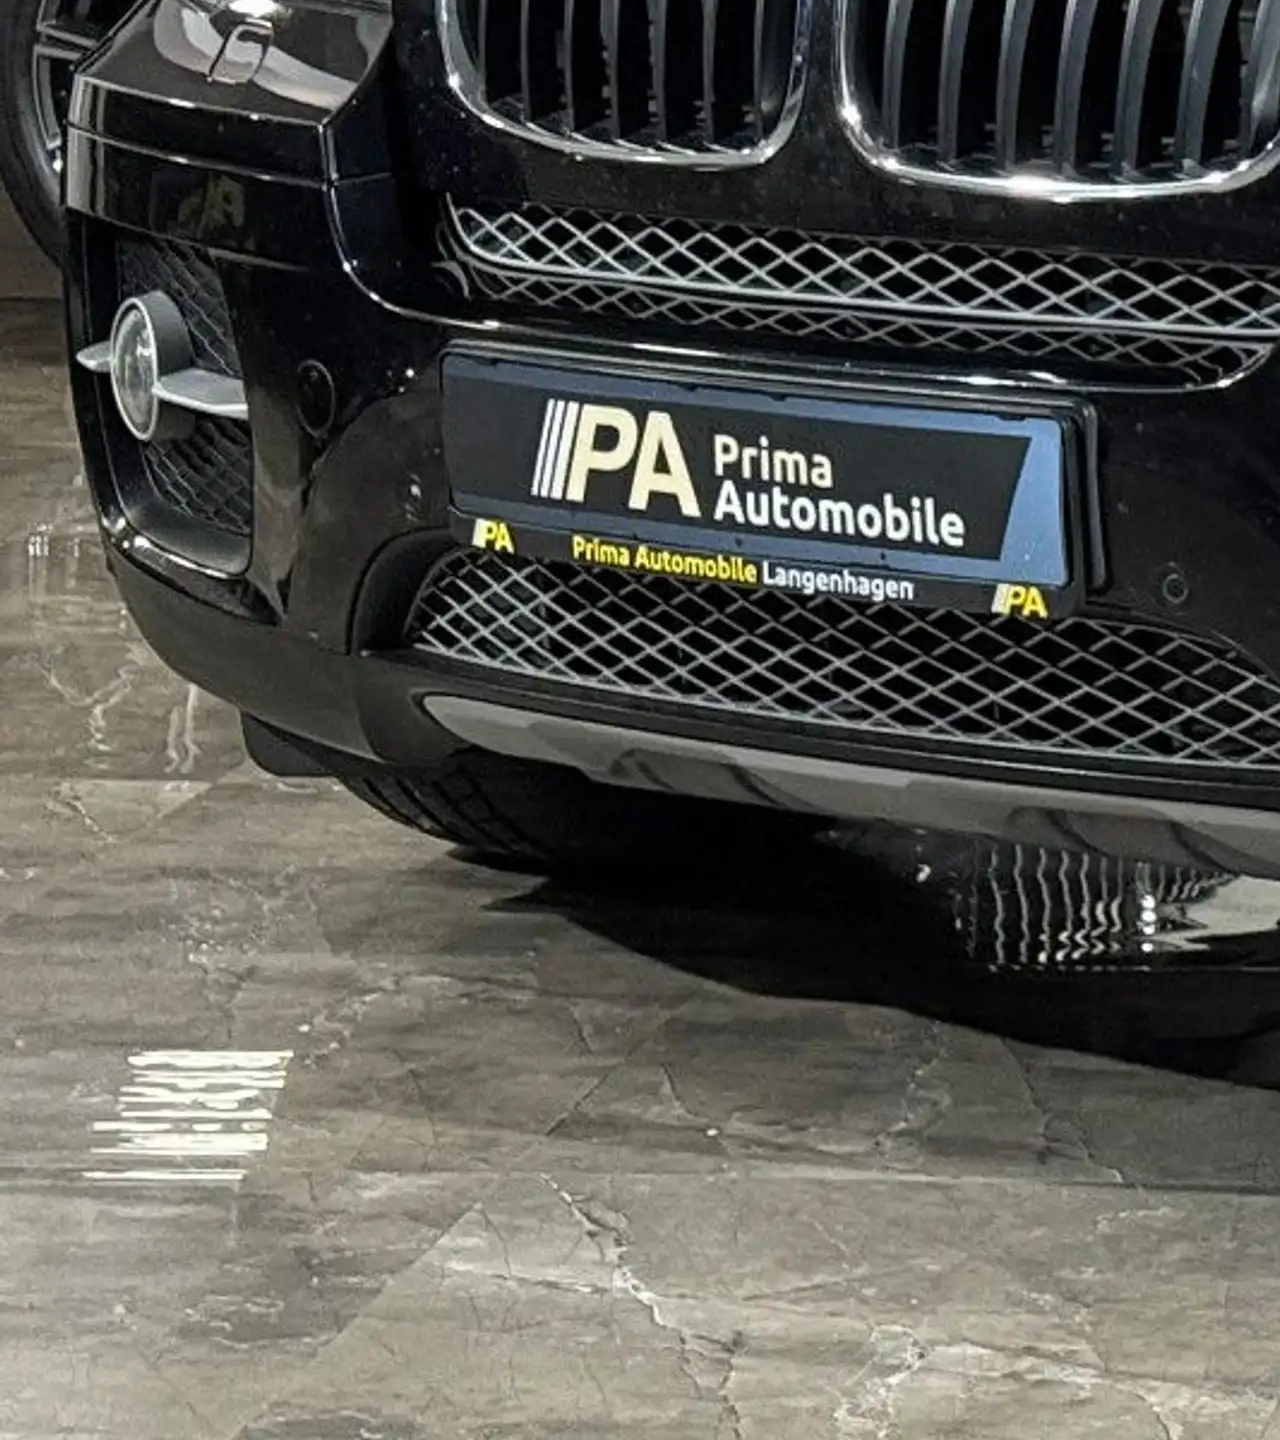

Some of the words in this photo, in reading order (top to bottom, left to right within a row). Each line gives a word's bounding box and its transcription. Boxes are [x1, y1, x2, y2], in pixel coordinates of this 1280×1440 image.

[566, 403, 702, 518] PA
[713, 433, 834, 489] Prima
[478, 519, 515, 555] PA
[713, 479, 966, 548] Automobile
[572, 534, 631, 567] Prima
[634, 544, 758, 584] Automobile
[762, 560, 915, 601] Langenhagen
[1001, 583, 1049, 620] PA
